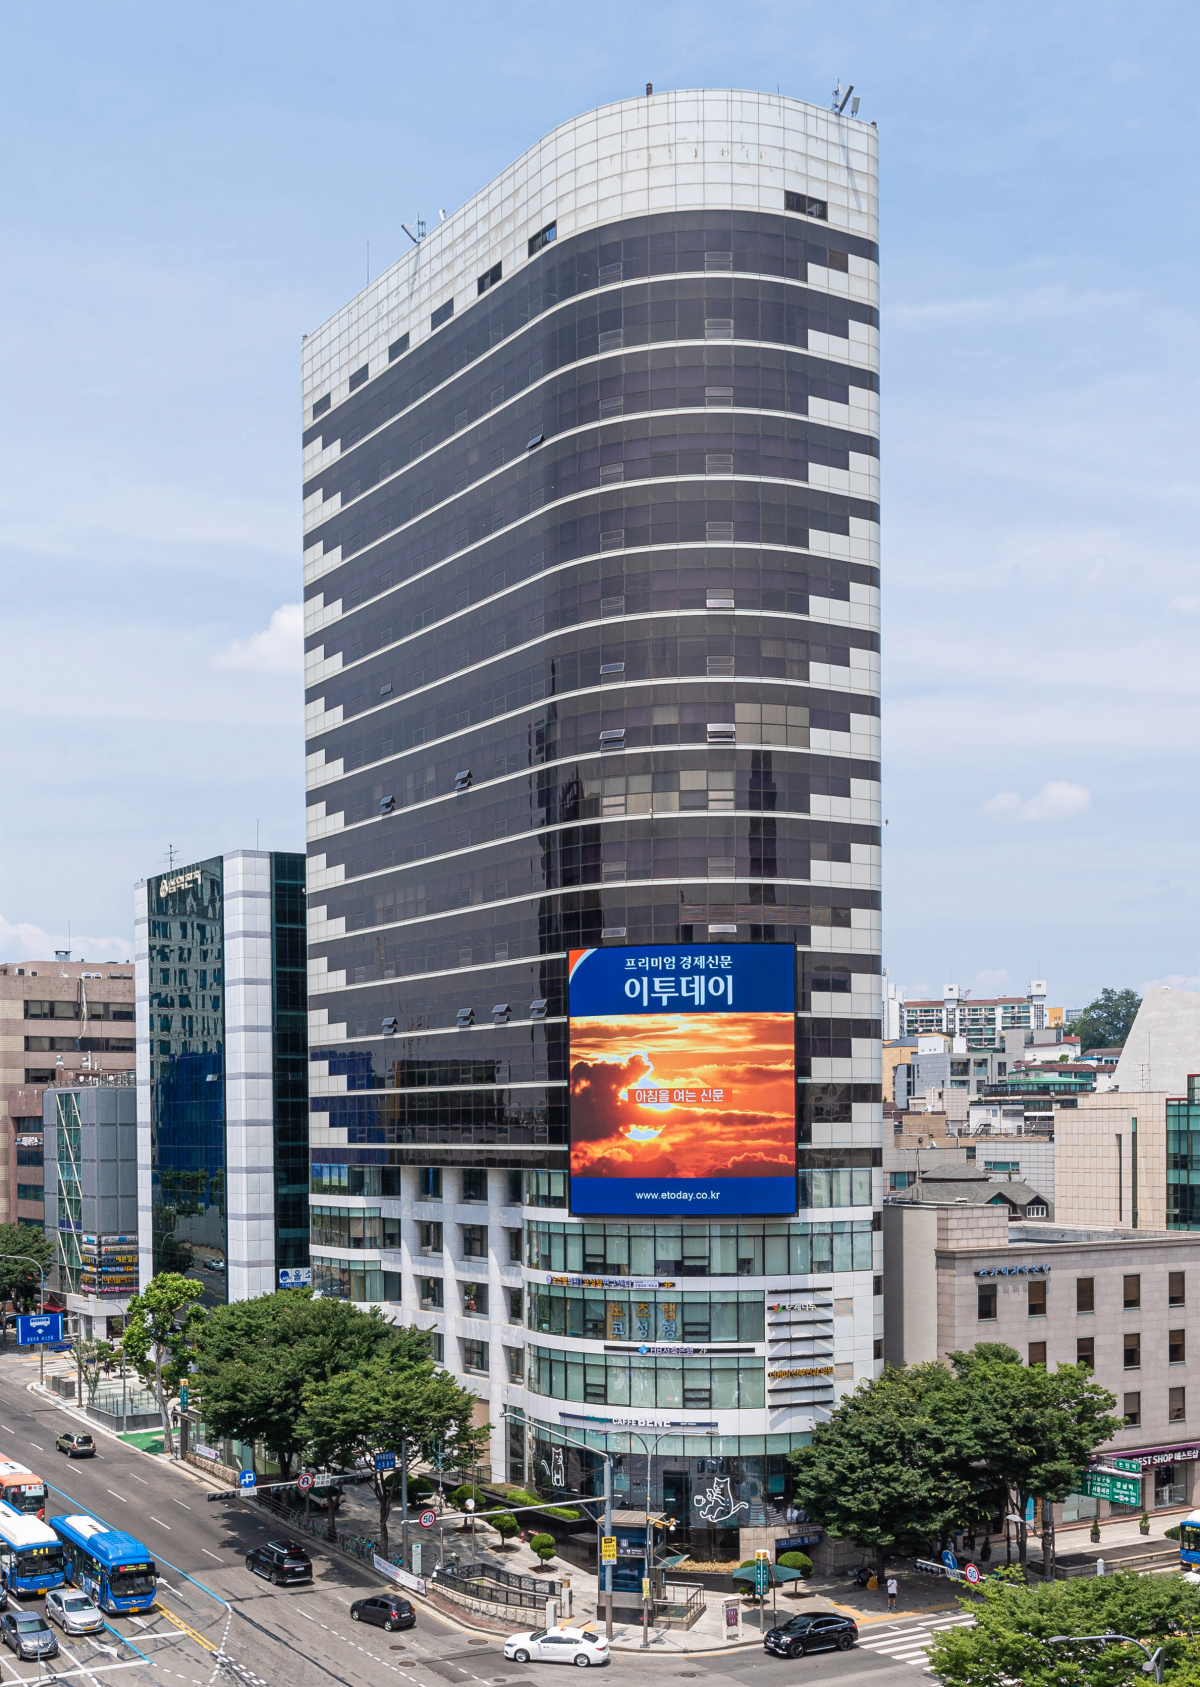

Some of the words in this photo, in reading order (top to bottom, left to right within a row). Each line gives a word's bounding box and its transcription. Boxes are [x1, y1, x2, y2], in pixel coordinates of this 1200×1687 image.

[624, 955, 676, 971] 프리미엄
[679, 955, 733, 969] 경제신문
[624, 974, 733, 1007] 이투데이
[635, 1090, 670, 1103] 아침을
[673, 1090, 697, 1103] 여는
[700, 1089, 724, 1102] 신문
[635, 1190, 720, 1202] www.etoday.co.kr
[611, 1303, 676, 1320] 노즈랩
[611, 1320, 676, 1339] 코성형
[612, 1417, 637, 1426] CAFFE
[637, 1415, 672, 1428] BENE
[1153, 1453, 1173, 1464] SHOP
[1174, 1449, 1199, 1460] 베스트샵
[422, 1514, 434, 1524] 50
[32, 1547, 49, 1556] 241
[968, 1569, 977, 1579] 50
